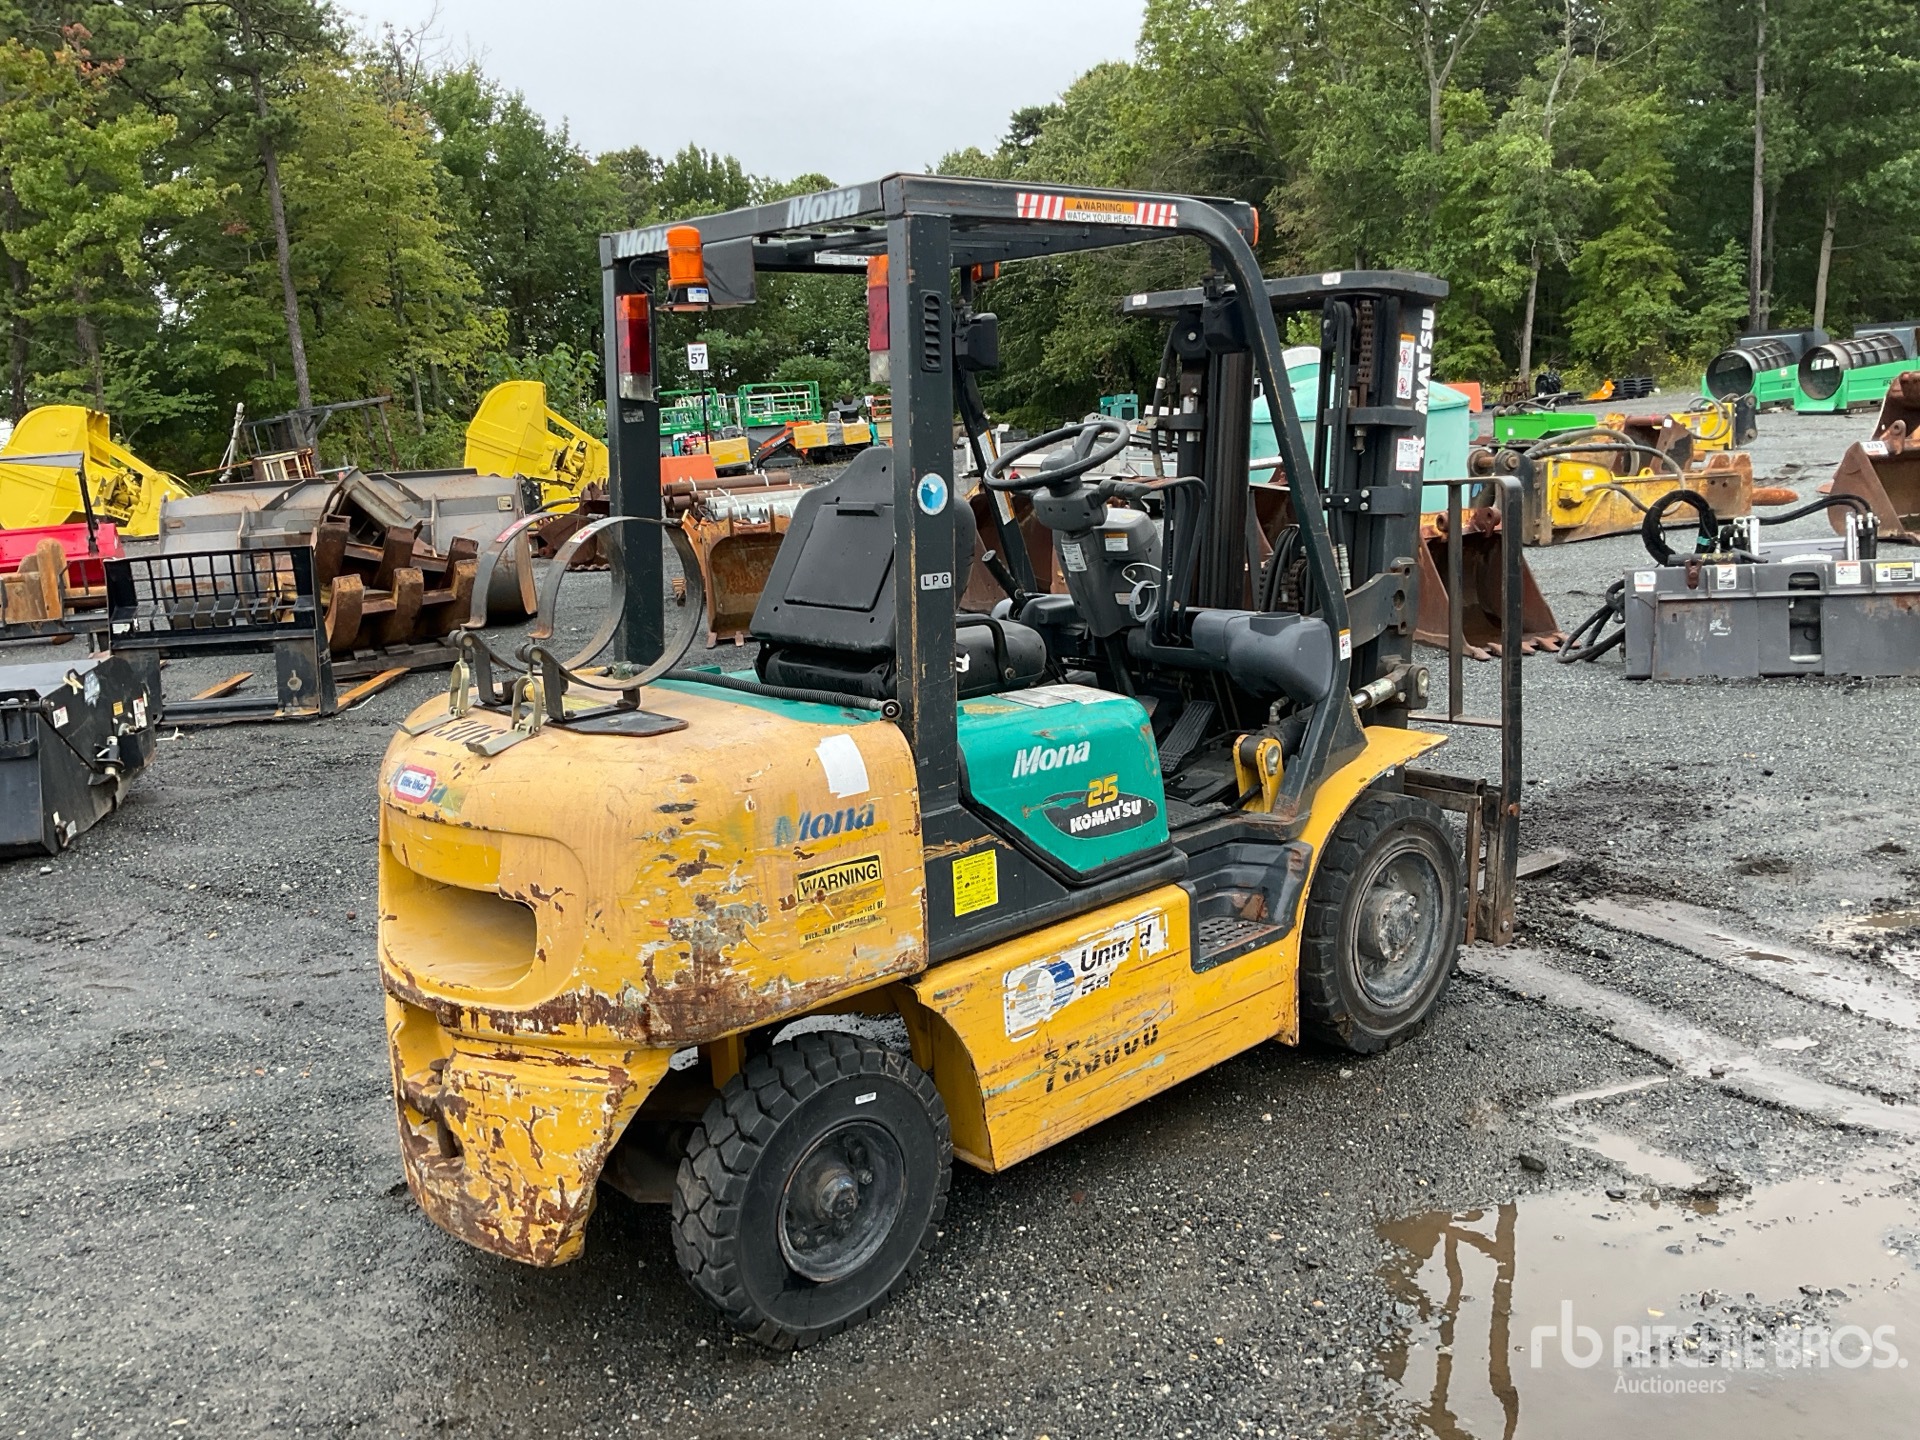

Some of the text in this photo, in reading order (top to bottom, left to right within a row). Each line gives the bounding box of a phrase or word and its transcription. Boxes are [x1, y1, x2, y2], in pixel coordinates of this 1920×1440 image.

[786, 188, 861, 229] Mona
[1066, 210, 1091, 221] WATCH
[1093, 213, 1113, 222] YOUR
[1083, 201, 1126, 213] WARNING!
[690, 352, 705, 365] 57
[923, 573, 950, 587] LPG
[1011, 740, 1091, 779] Mona
[1087, 774, 1119, 808] 25
[773, 803, 876, 848] Mona
[1069, 799, 1142, 834] KOMATSU
[800, 863, 878, 897] WARNING
